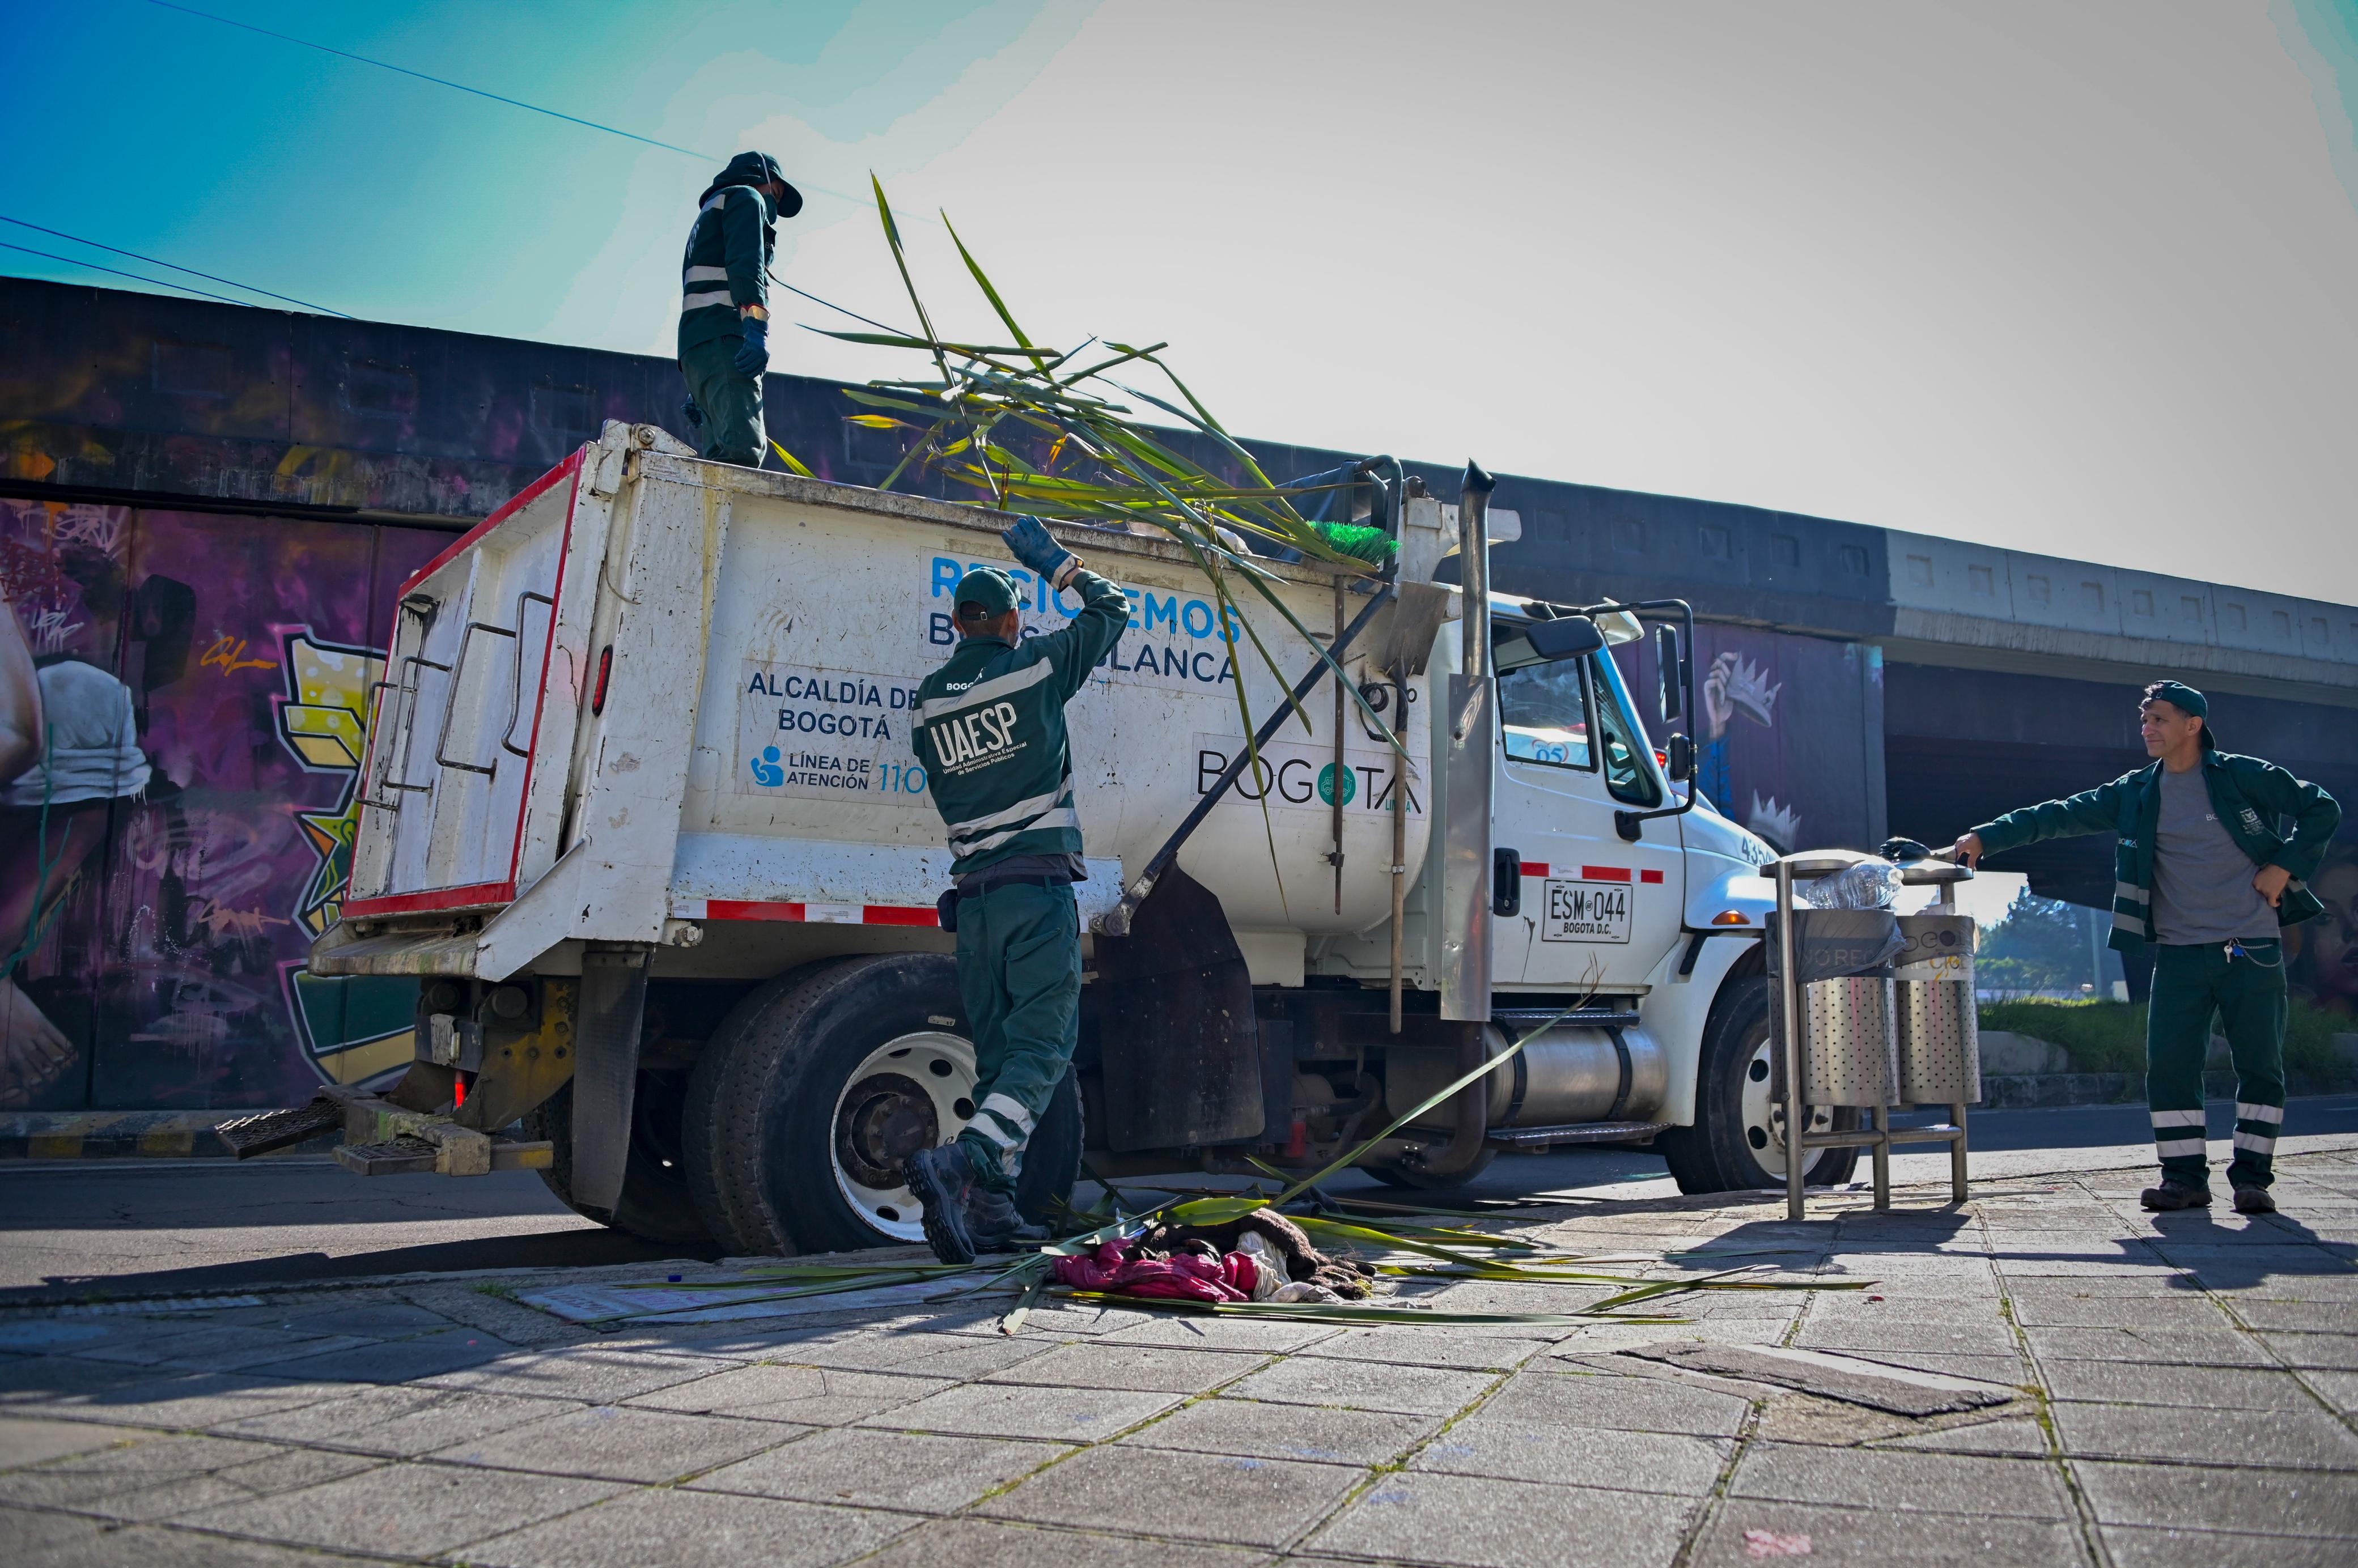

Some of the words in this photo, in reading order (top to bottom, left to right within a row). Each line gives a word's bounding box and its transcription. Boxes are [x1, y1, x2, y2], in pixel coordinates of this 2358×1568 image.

[748, 672, 883, 708] ALCALDÍA
[779, 708, 891, 741] BOGOTÁ
[930, 702, 1017, 767] UAESP
[789, 750, 842, 771] LÍNEA
[847, 758, 870, 774] DE
[943, 763, 962, 775] Unidad
[963, 751, 1002, 768] Administrativa
[1002, 741, 1027, 754] Especial
[965, 761, 990, 773] Servicios
[787, 771, 869, 791] ATENCIÓN
[879, 763, 928, 794] 110
[1551, 889, 1585, 920] ESM
[1594, 891, 1625, 922] 044
[1563, 922, 1594, 934] BOGOTA
[1597, 923, 1611, 934] D.C.
